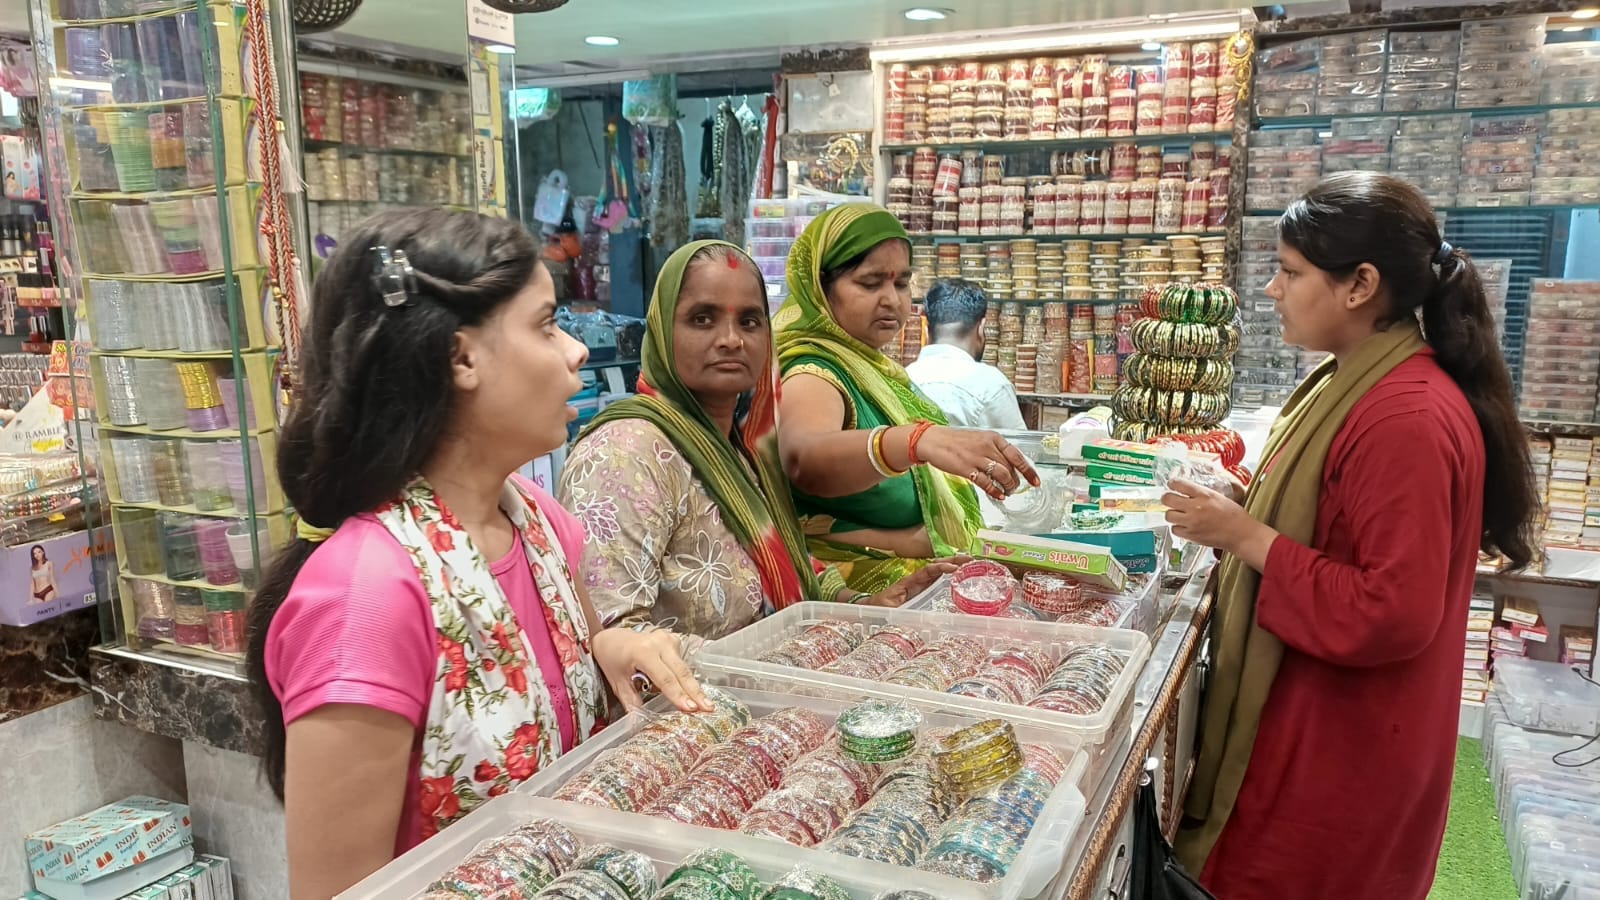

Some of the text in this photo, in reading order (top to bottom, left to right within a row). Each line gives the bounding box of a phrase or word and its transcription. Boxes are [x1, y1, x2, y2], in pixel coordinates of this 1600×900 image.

[1049, 550, 1089, 570] Uwais
[36, 606, 55, 616] PANTY
[146, 823, 177, 849] INDIAN
